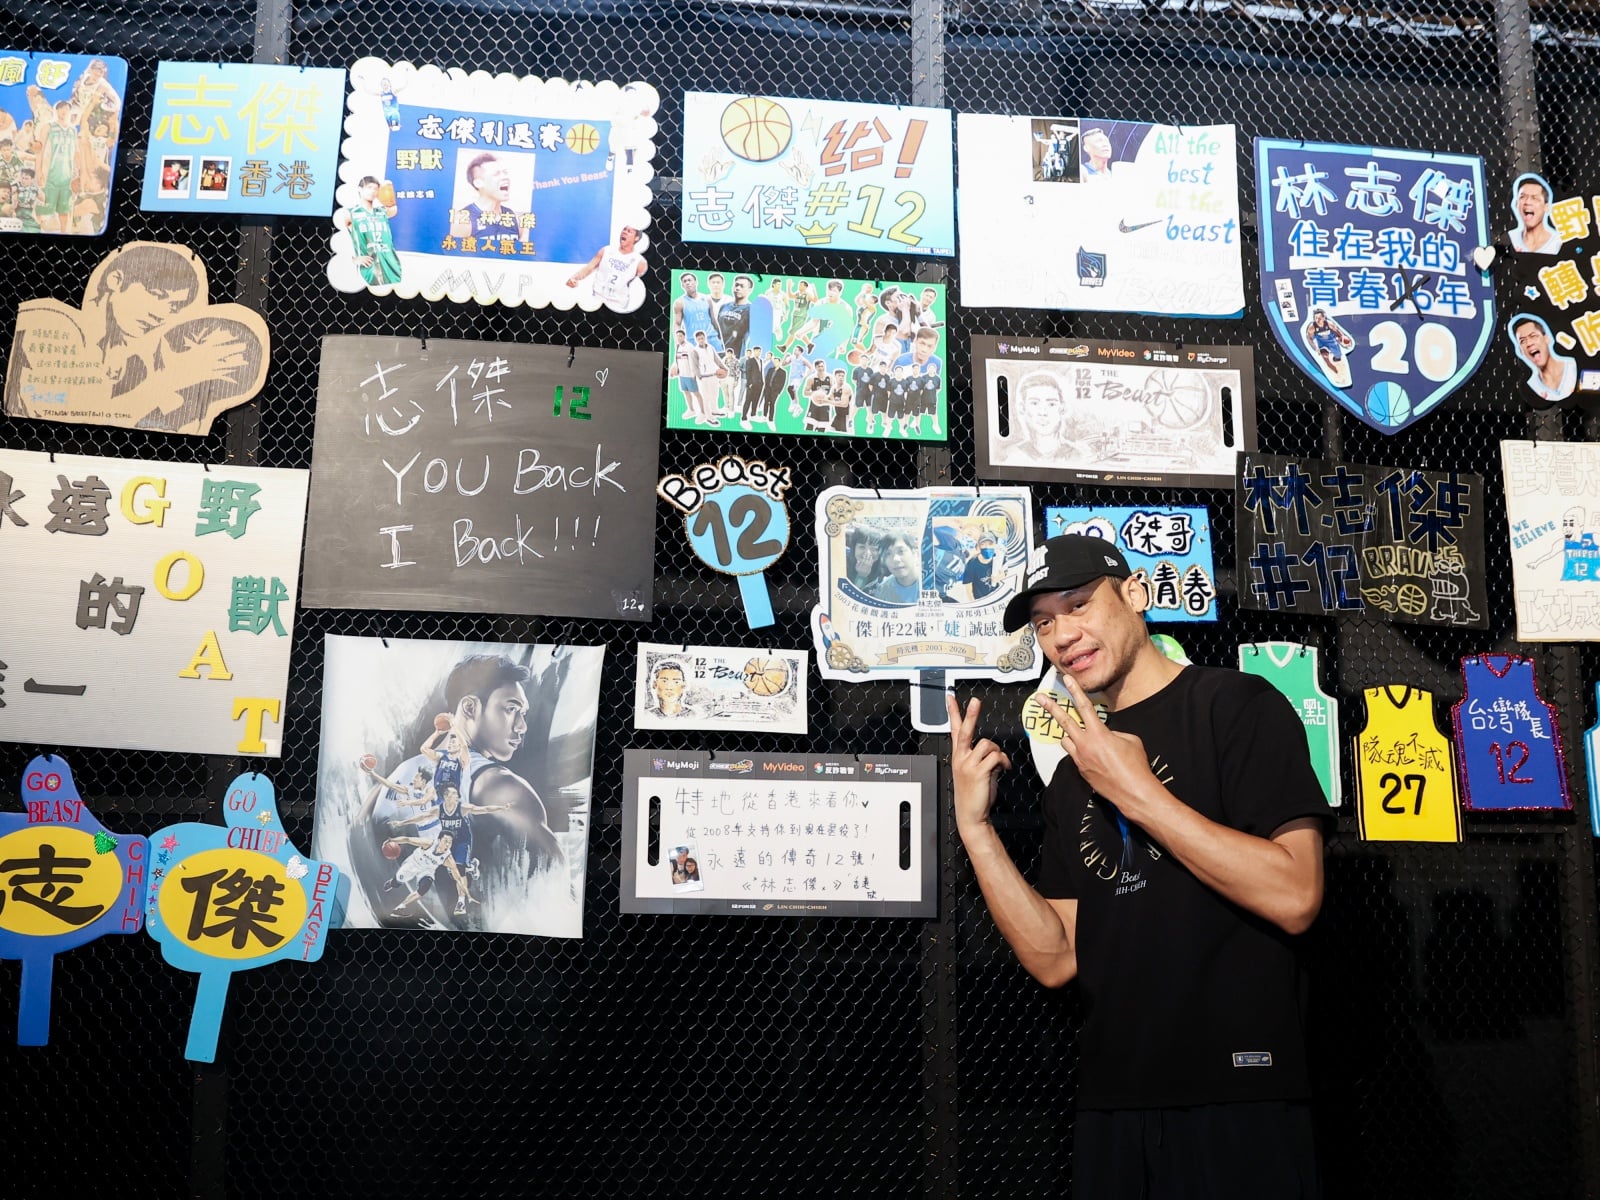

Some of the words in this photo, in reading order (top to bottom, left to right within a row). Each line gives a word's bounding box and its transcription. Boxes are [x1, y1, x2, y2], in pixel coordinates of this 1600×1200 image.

[155, 75, 323, 155] 志傑
[1155, 131, 1180, 155] All
[1187, 132, 1221, 156] the
[396, 149, 443, 171] 野獸
[1167, 159, 1215, 185] best
[239, 160, 314, 200] 香港
[562, 175, 580, 186] You
[1272, 161, 1474, 233] 林志傑
[449, 209, 471, 225] 12
[480, 211, 536, 230] 林志傑
[1165, 214, 1236, 244] beast
[442, 235, 536, 256] 永遠人氣王
[1289, 219, 1461, 272] 住在我的
[1010, 345, 1040, 355] MyMoji
[1097, 347, 1135, 358] MyVideo
[1368, 320, 1457, 382] 20
[1075, 368, 1092, 379] 12
[1100, 369, 1119, 377] THE
[359, 356, 512, 436] 志傑
[552, 385, 592, 420] 12
[1075, 387, 1091, 399] 12
[381, 451, 490, 505] YOU
[513, 444, 626, 497] Back
[661, 457, 790, 512] Beast
[1243, 463, 1471, 552] 林志傑
[692, 494, 782, 566] 12
[1123, 515, 1192, 553] 傑哥
[1512, 519, 1530, 534] WE
[1512, 520, 1557, 550] BELIEVE
[379, 524, 417, 569] I
[1249, 541, 1365, 611] #12
[1573, 563, 1589, 577] 12
[76, 572, 145, 635] 的
[622, 598, 638, 611] 12
[694, 670, 706, 679] 12
[695, 657, 707, 666] 12
[1468, 697, 1550, 739] 台灣隊長
[666, 760, 700, 771] MyMoji
[763, 761, 805, 772] MyVideo
[1363, 733, 1445, 772] 隊魂不滅
[1488, 740, 1534, 785] 12
[26, 771, 62, 791] GO
[874, 767, 908, 777] MyCharge
[228, 788, 257, 813] GO
[1379, 772, 1426, 816] 27
[27, 799, 86, 823] BEAST
[0, 843, 105, 926] 志
[121, 841, 144, 931] CHIH
[181, 867, 285, 949] 傑
[302, 863, 333, 960] BEAST
